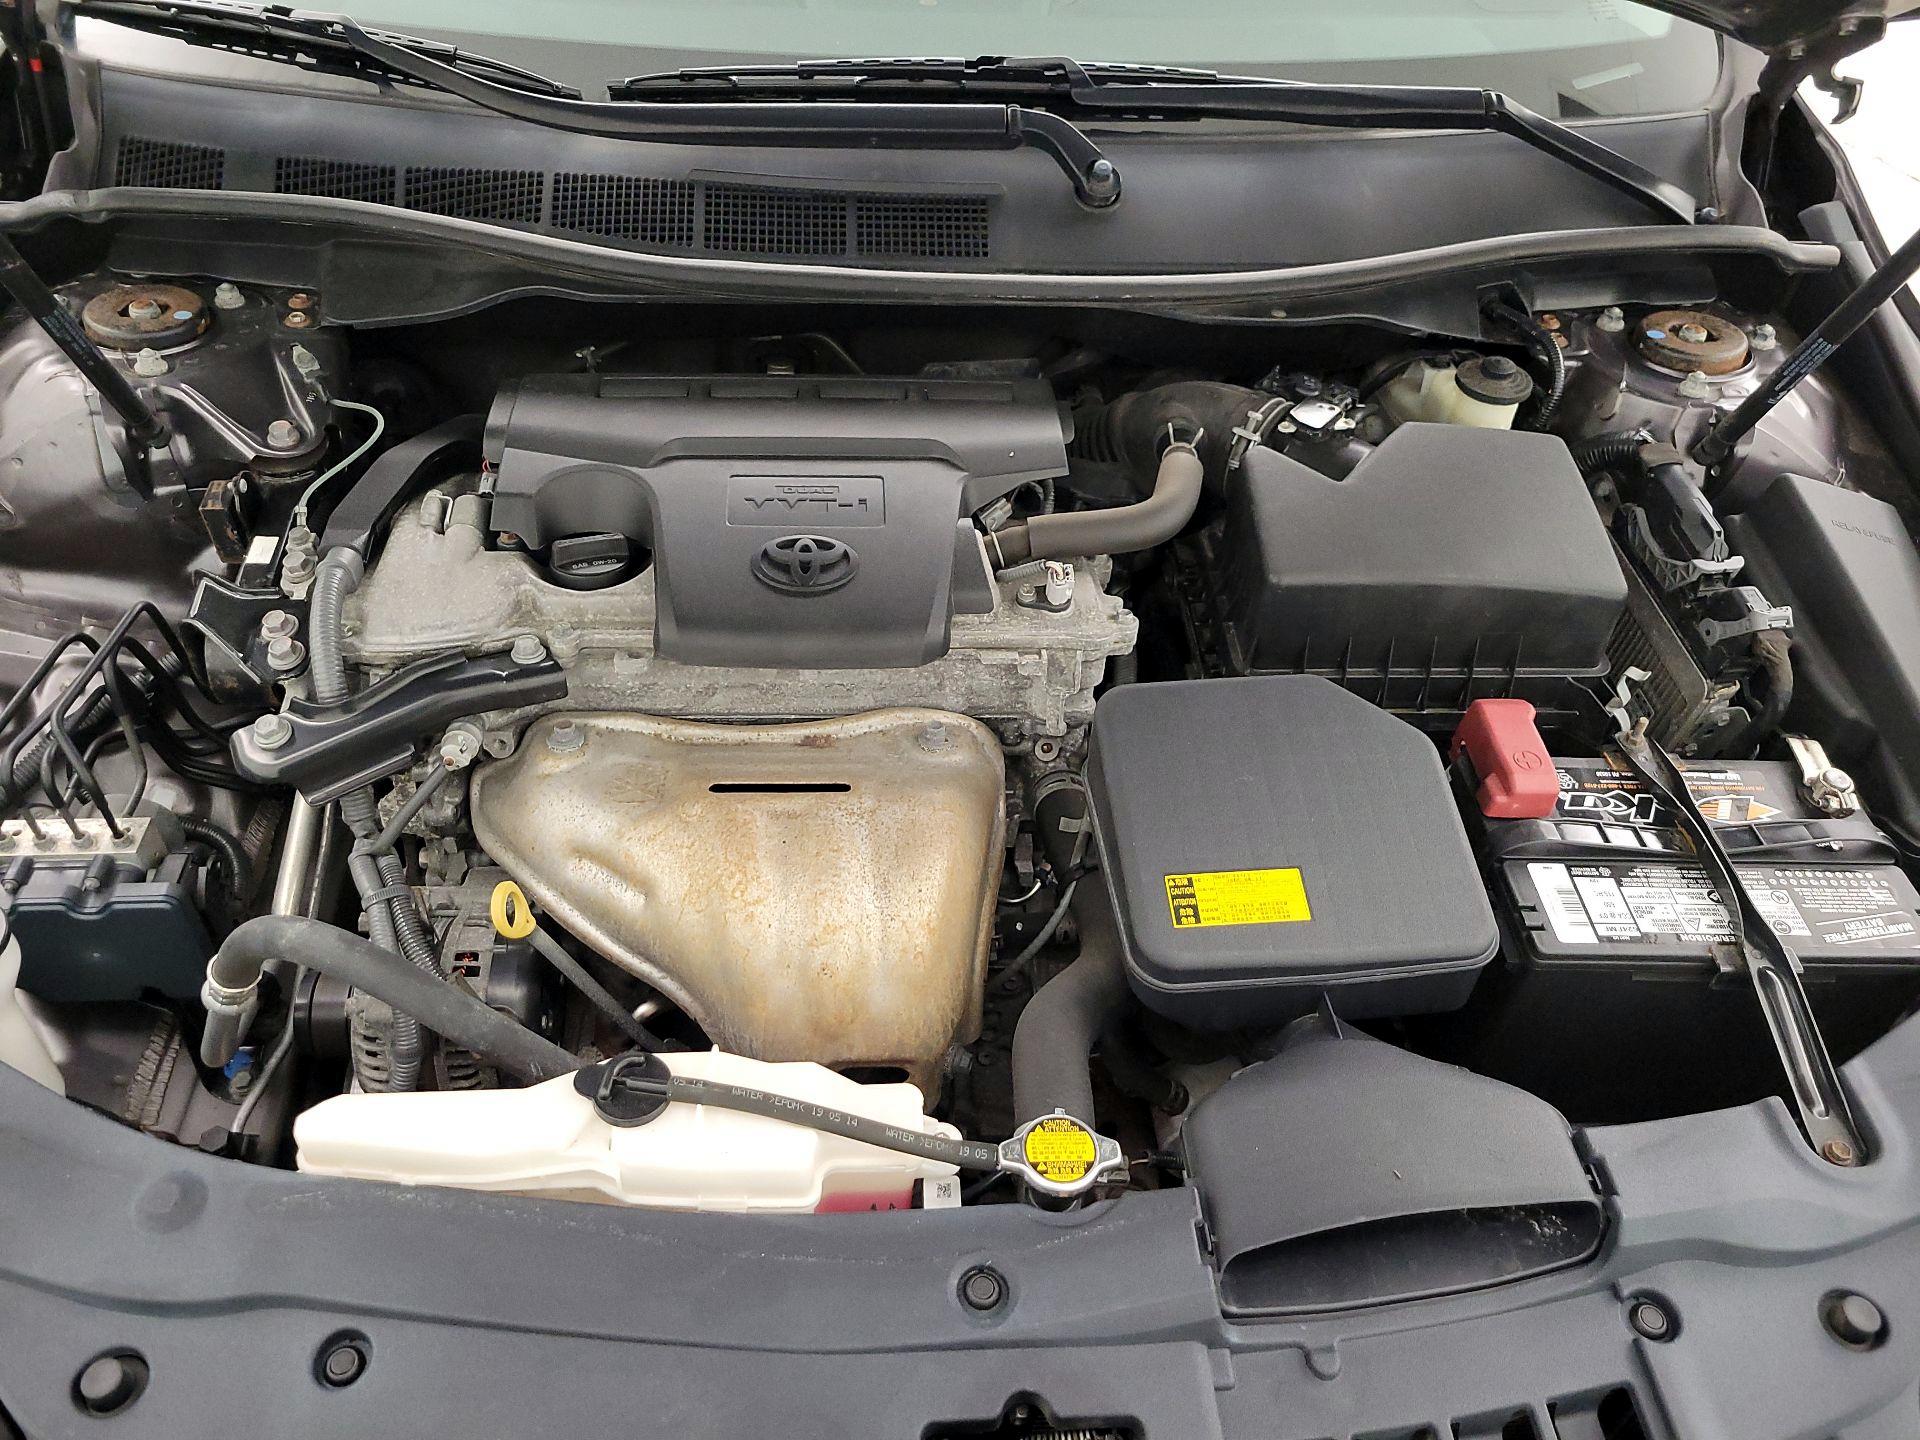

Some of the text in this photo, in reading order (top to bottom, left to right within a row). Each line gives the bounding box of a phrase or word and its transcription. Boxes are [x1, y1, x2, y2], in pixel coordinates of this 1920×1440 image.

[1171, 886, 1195, 895] CAUTION
[1822, 922, 1915, 944] MAINTENANCE-FREE
[1843, 917, 1885, 933] BATTERY
[731, 1087, 764, 1100] WATER
[811, 1106, 824, 1117] 19
[829, 1111, 841, 1122] 05
[846, 1116, 858, 1127] 14
[1043, 1119, 1071, 1127] CAUTION
[885, 1127, 915, 1143] WATER
[959, 1146, 970, 1157] 19
[975, 1148, 988, 1160] 05
